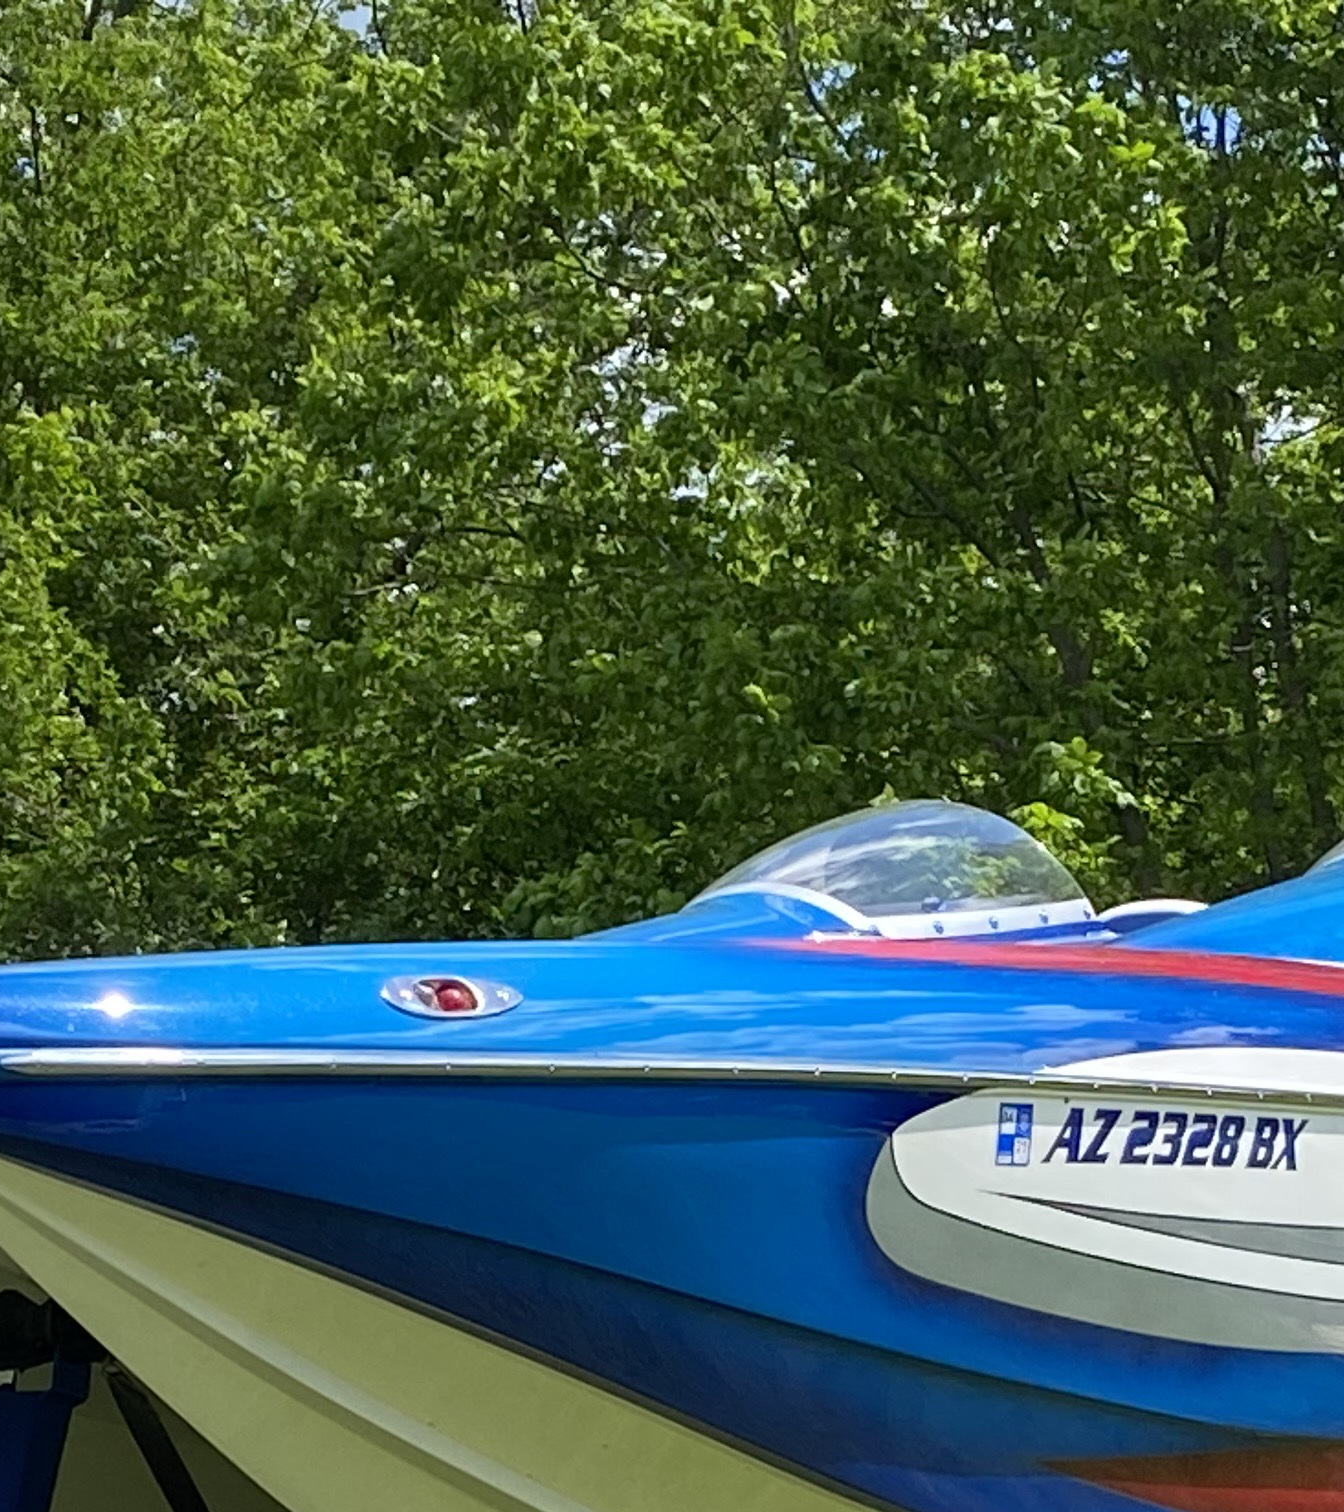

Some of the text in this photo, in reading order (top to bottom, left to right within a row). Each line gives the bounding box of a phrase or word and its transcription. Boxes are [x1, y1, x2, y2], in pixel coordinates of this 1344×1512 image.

[1040, 1107, 1309, 1171] AZ 2328 BX
